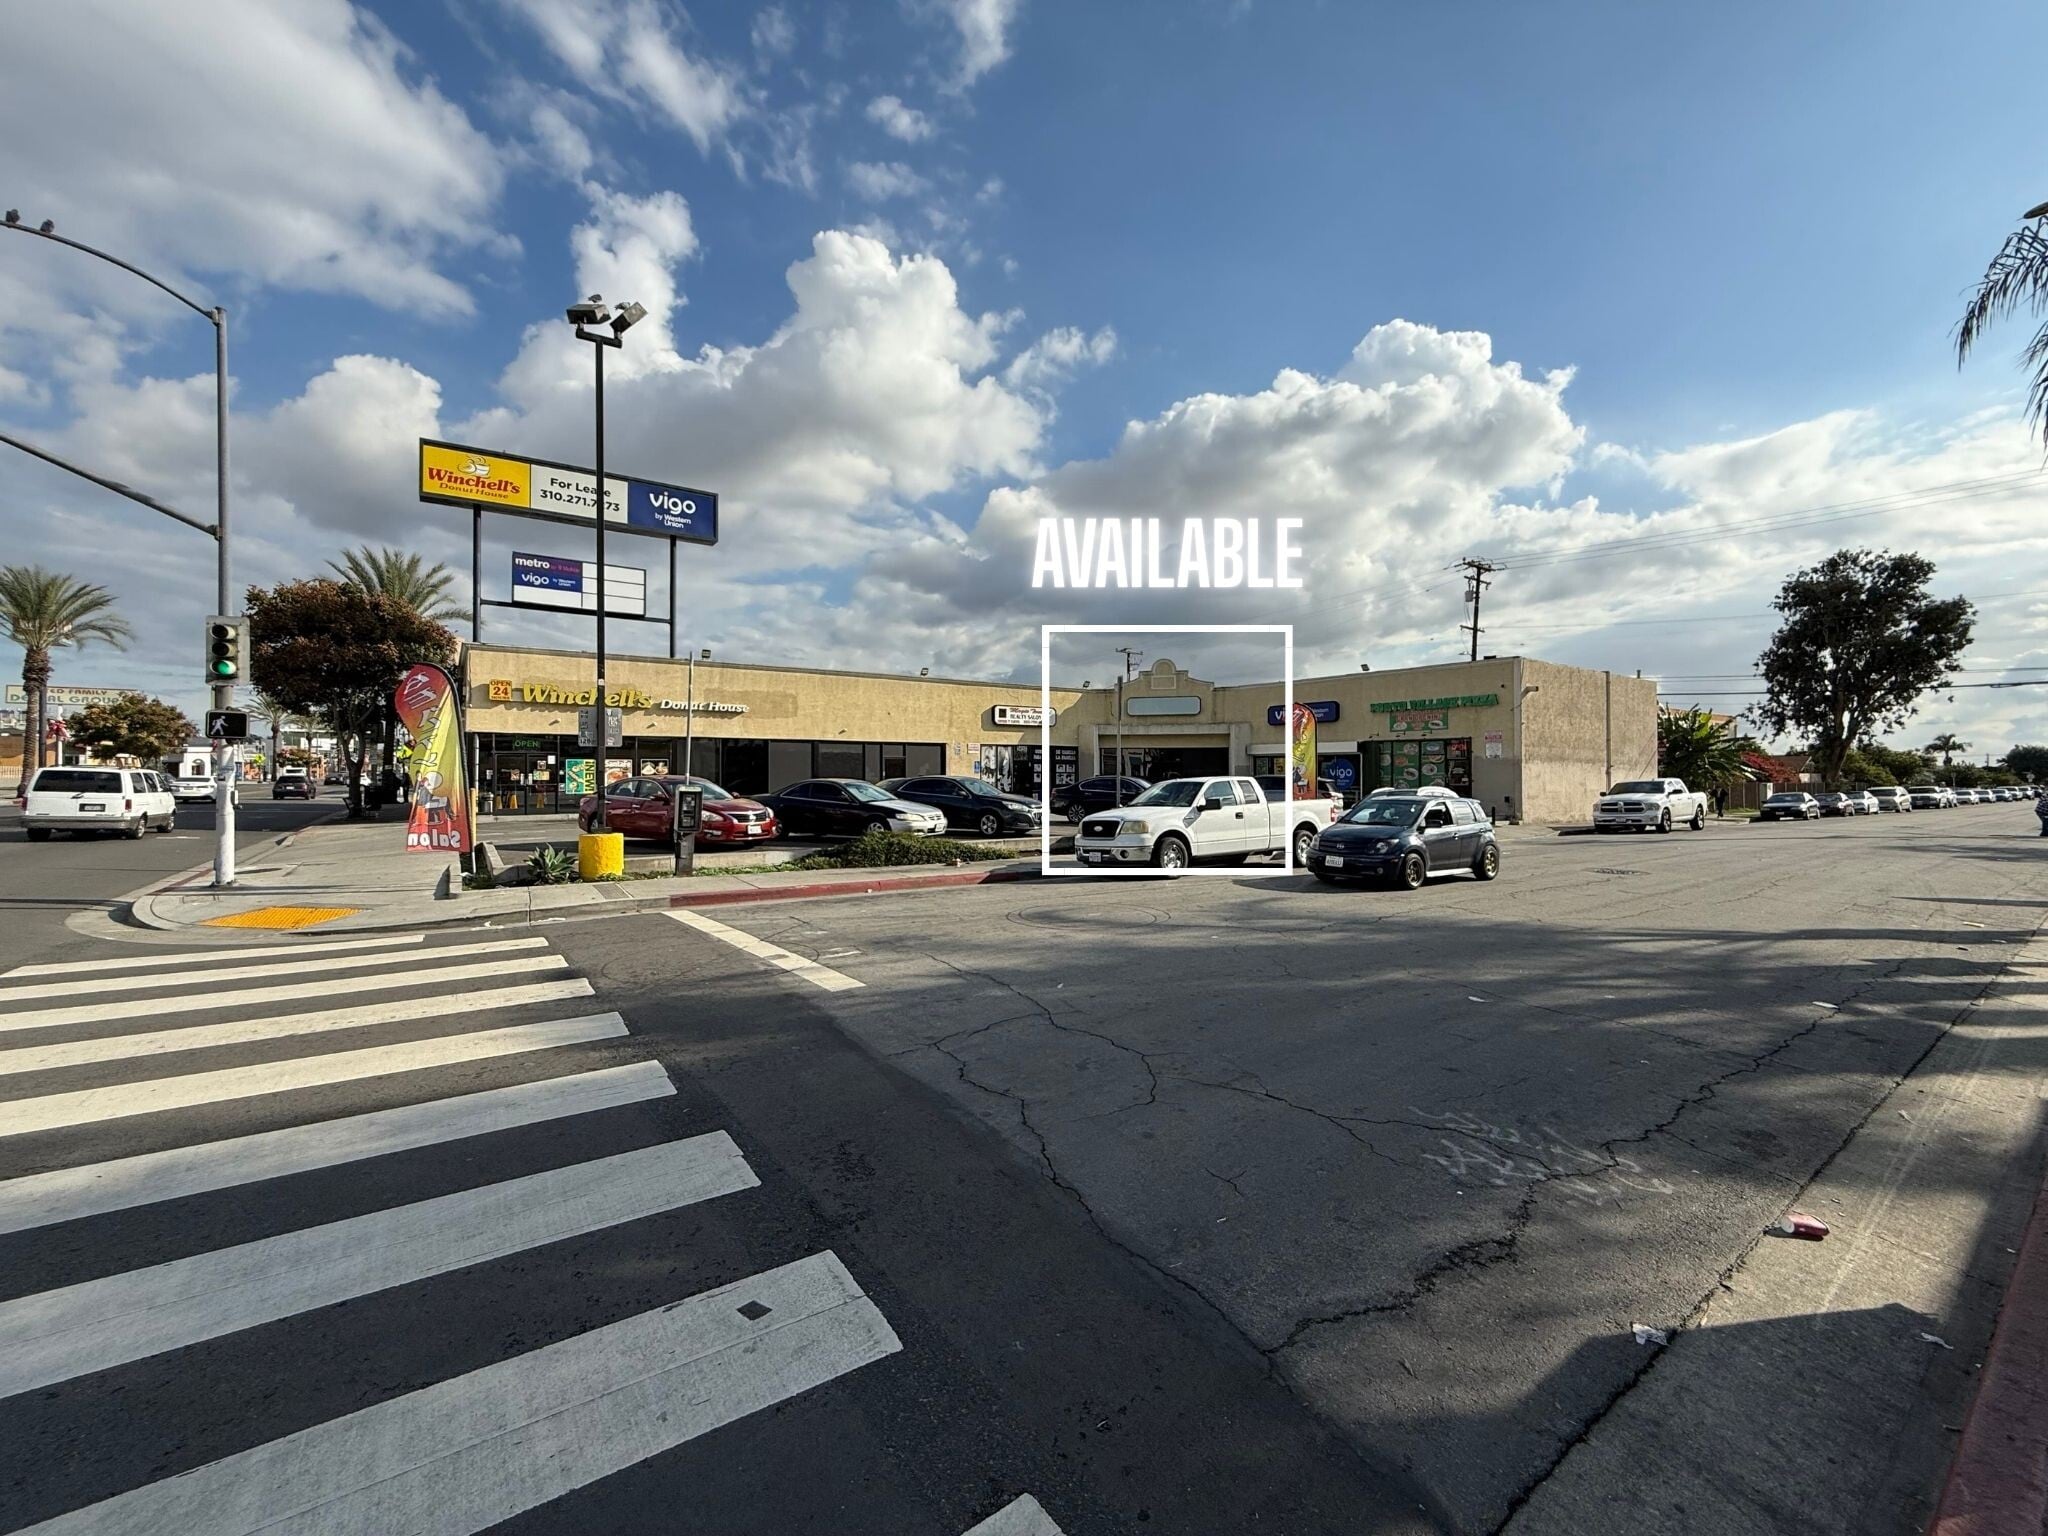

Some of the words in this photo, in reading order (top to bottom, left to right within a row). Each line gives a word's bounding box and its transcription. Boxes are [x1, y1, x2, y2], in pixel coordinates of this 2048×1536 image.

[428, 467, 520, 494] Winchell's
[440, 482, 473, 493] Donut
[475, 489, 509, 499] House
[550, 477, 572, 490] For
[575, 482, 611, 498] Leae
[540, 489, 620, 511] 310.271.773
[649, 491, 696, 515] vigo
[655, 512, 663, 521] by
[664, 514, 691, 524] Western
[664, 520, 684, 528] Union
[515, 557, 550, 569] metro
[521, 572, 549, 585] vigo
[493, 686, 508, 696] 24
[660, 699, 705, 710] Donut
[708, 701, 750, 712] House
[1329, 766, 1353, 779] vigo
